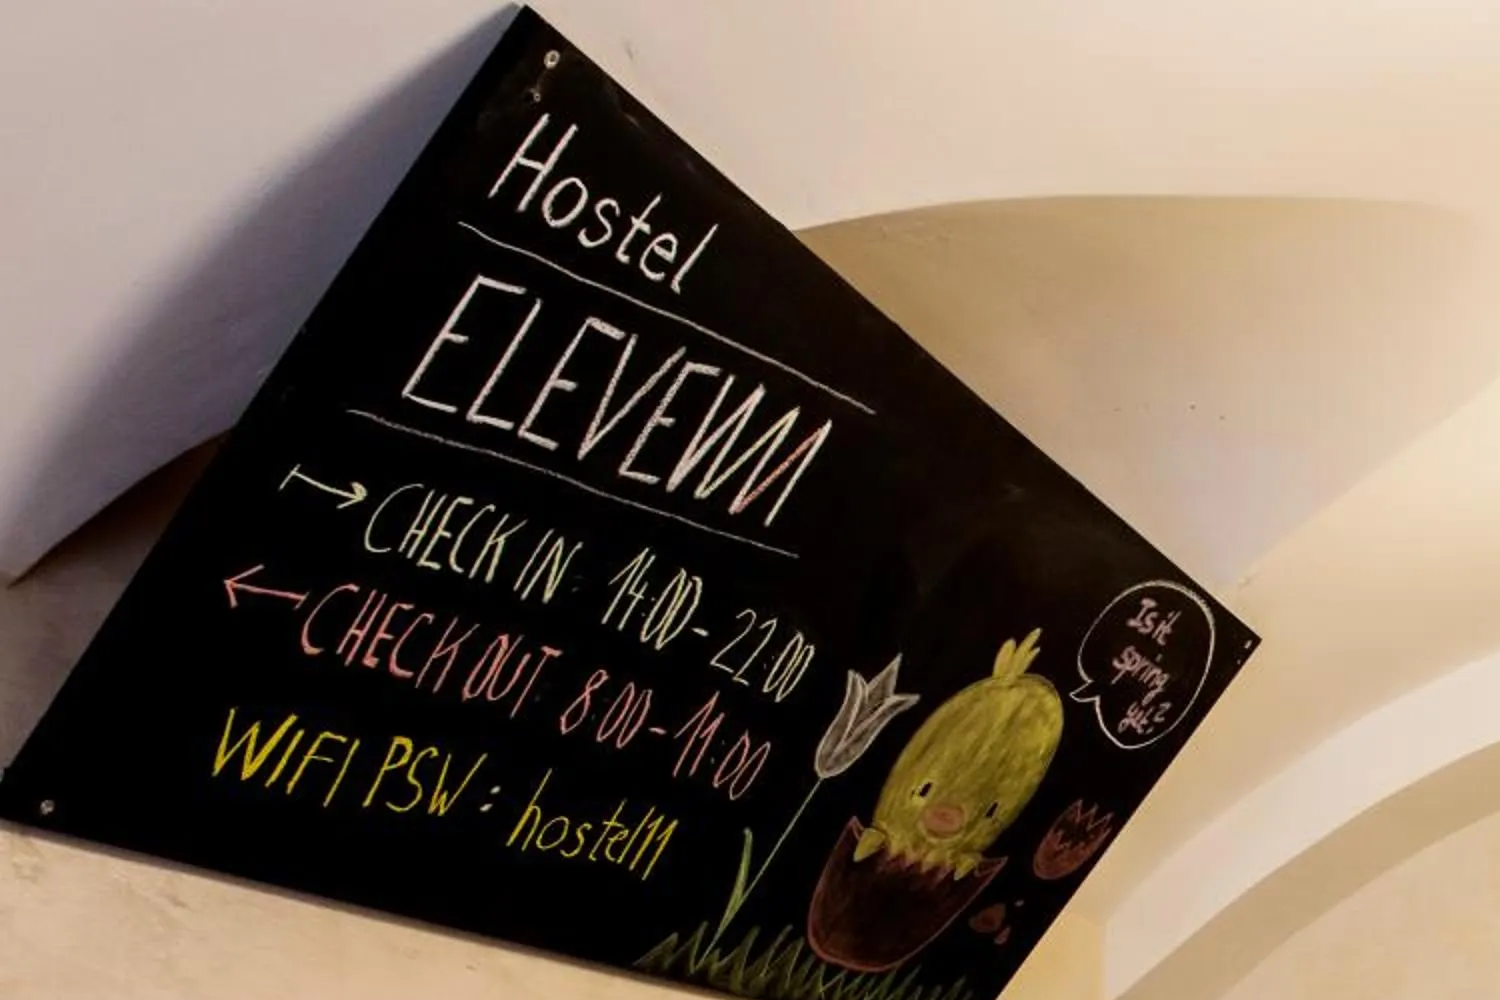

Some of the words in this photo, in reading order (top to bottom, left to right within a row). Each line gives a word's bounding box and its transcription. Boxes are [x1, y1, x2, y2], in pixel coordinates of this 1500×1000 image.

[489, 113, 718, 294] Hostel
[364, 483, 527, 583] CHECK
[300, 584, 480, 694] CHECK
[212, 707, 360, 807] WIFI
